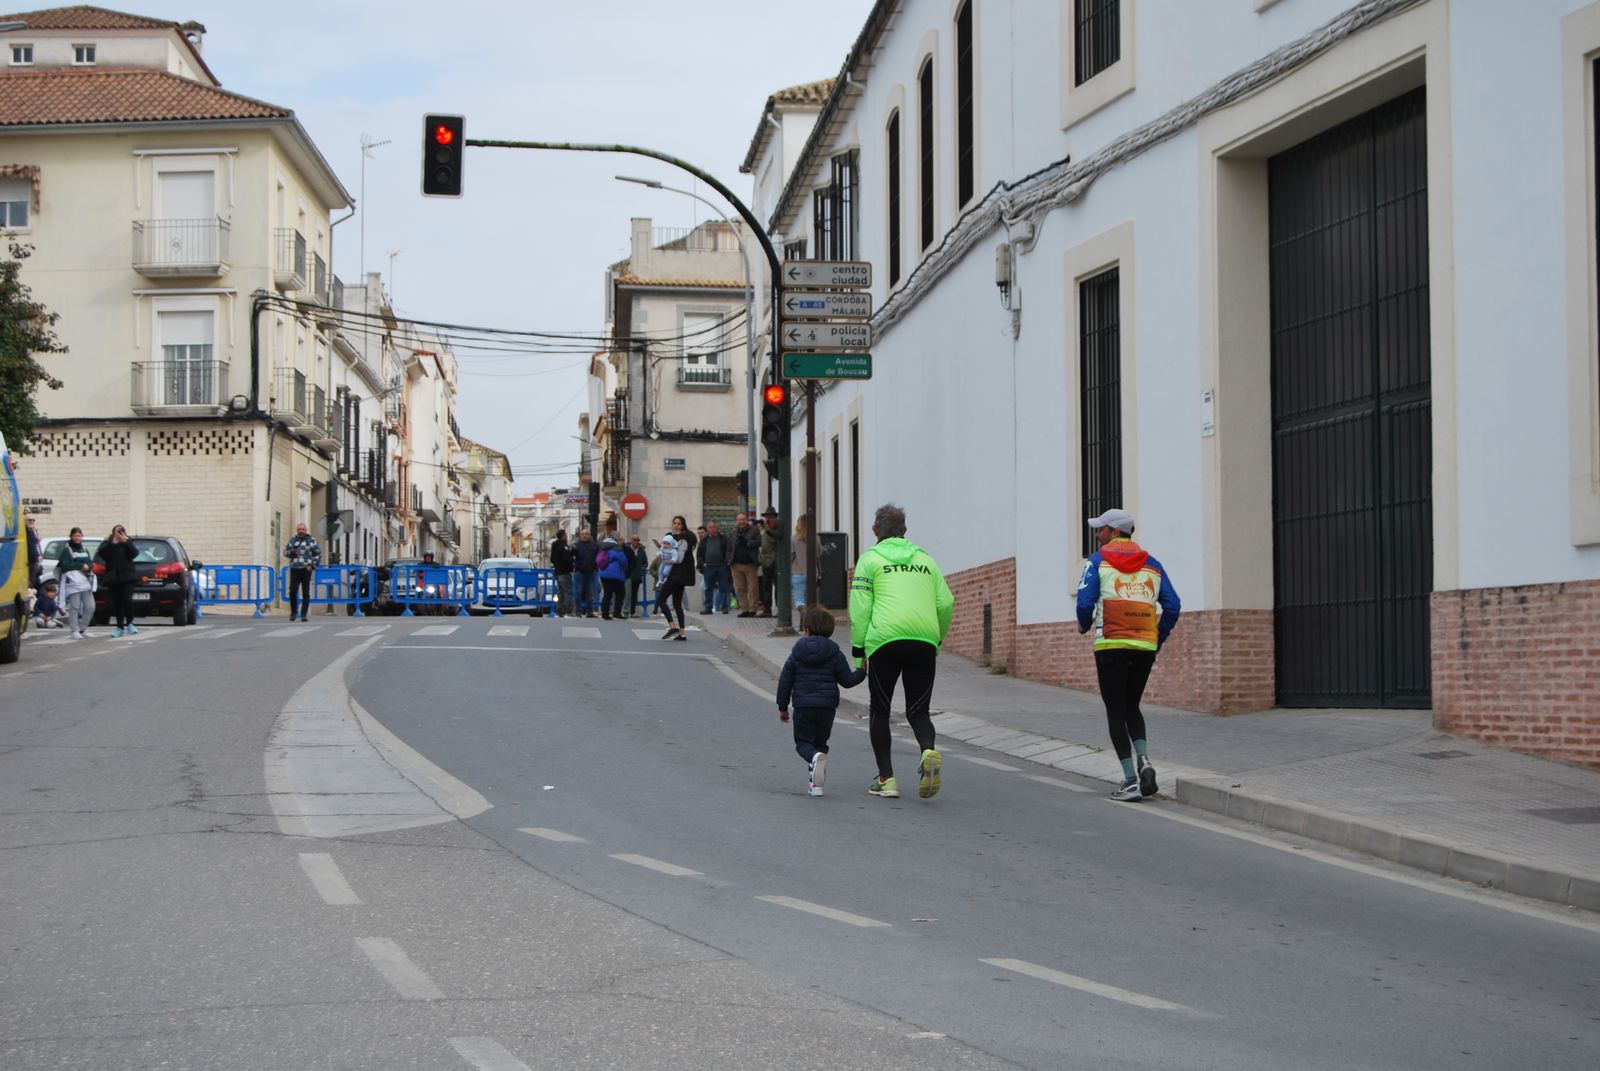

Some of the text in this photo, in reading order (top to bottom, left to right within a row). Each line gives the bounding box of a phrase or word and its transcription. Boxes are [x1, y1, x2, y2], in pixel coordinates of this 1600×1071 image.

[832, 265, 867, 274] centro
[832, 275, 867, 285] ciudad
[826, 295, 867, 304] CÓRDOBA
[832, 307, 867, 315] MÁLAGA
[831, 325, 867, 336] policía
[841, 337, 867, 346] local
[835, 357, 867, 365] Avenida
[826, 367, 868, 375] de Boucau
[883, 564, 931, 575] STRAVA
